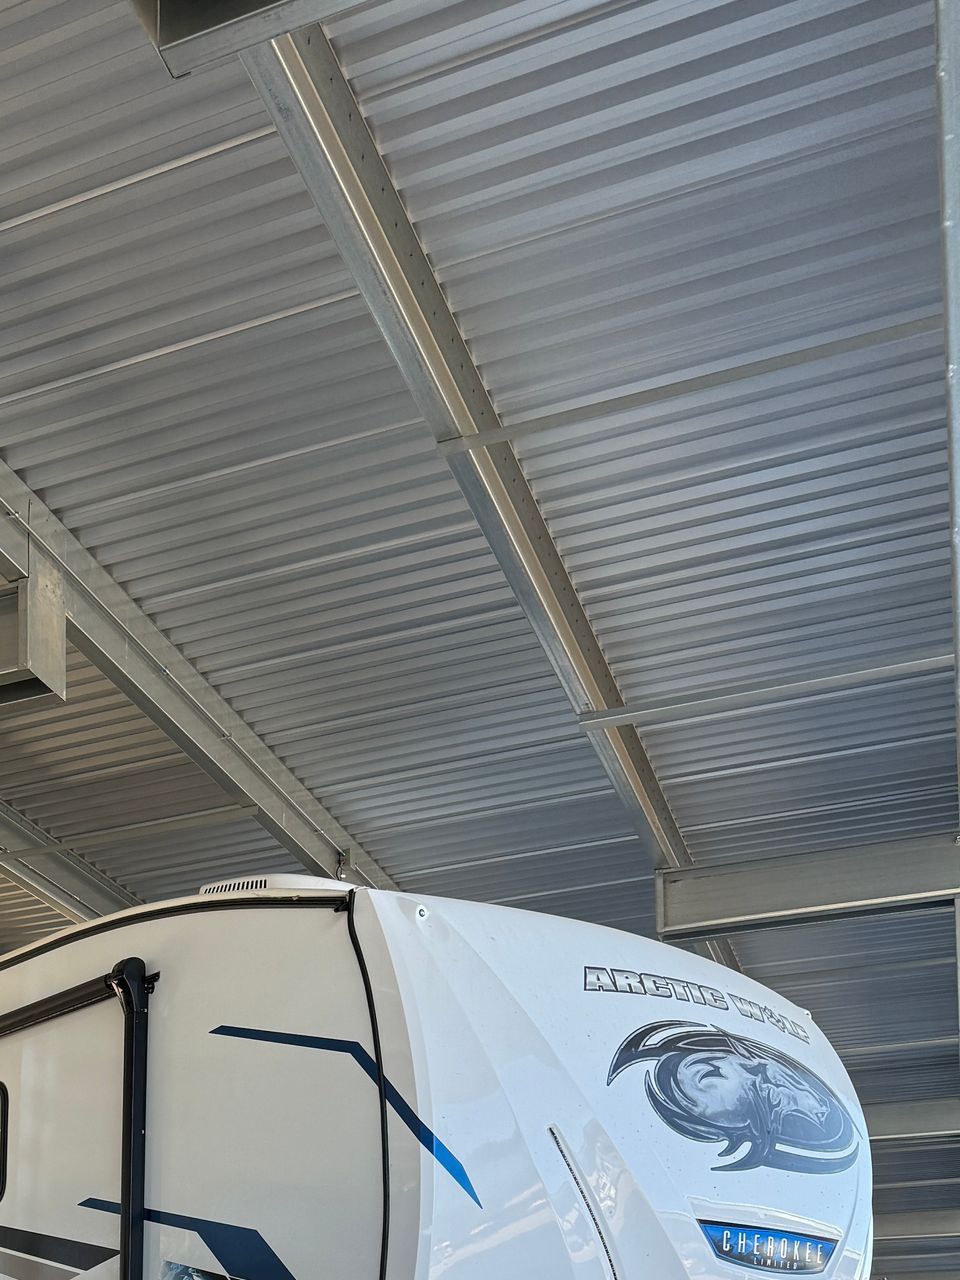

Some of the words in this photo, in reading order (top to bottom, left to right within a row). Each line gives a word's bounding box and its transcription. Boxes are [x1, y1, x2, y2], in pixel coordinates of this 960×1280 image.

[584, 965, 729, 1010] ARCTIC
[722, 1230, 823, 1264] CHEROKEE
[753, 1257, 799, 1271] LIMITED
